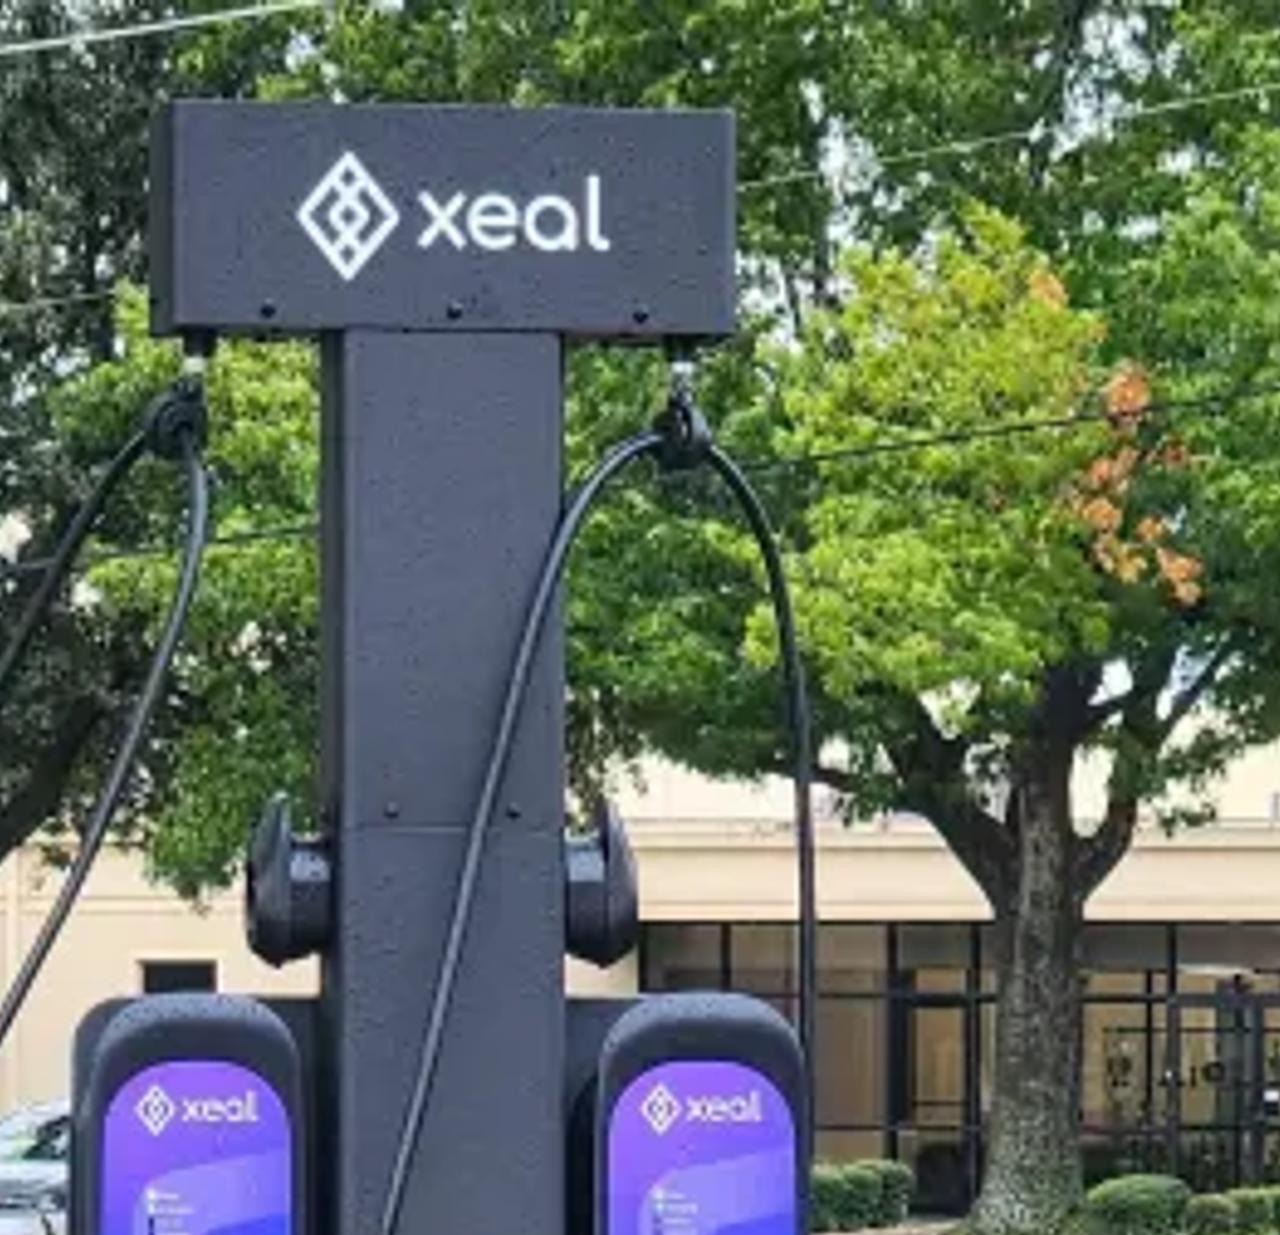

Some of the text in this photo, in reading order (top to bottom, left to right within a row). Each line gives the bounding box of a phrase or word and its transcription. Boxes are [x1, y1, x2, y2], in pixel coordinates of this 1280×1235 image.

[418, 175, 610, 251] xeal
[181, 1090, 259, 1123] xeal
[686, 1090, 762, 1123] xeal
